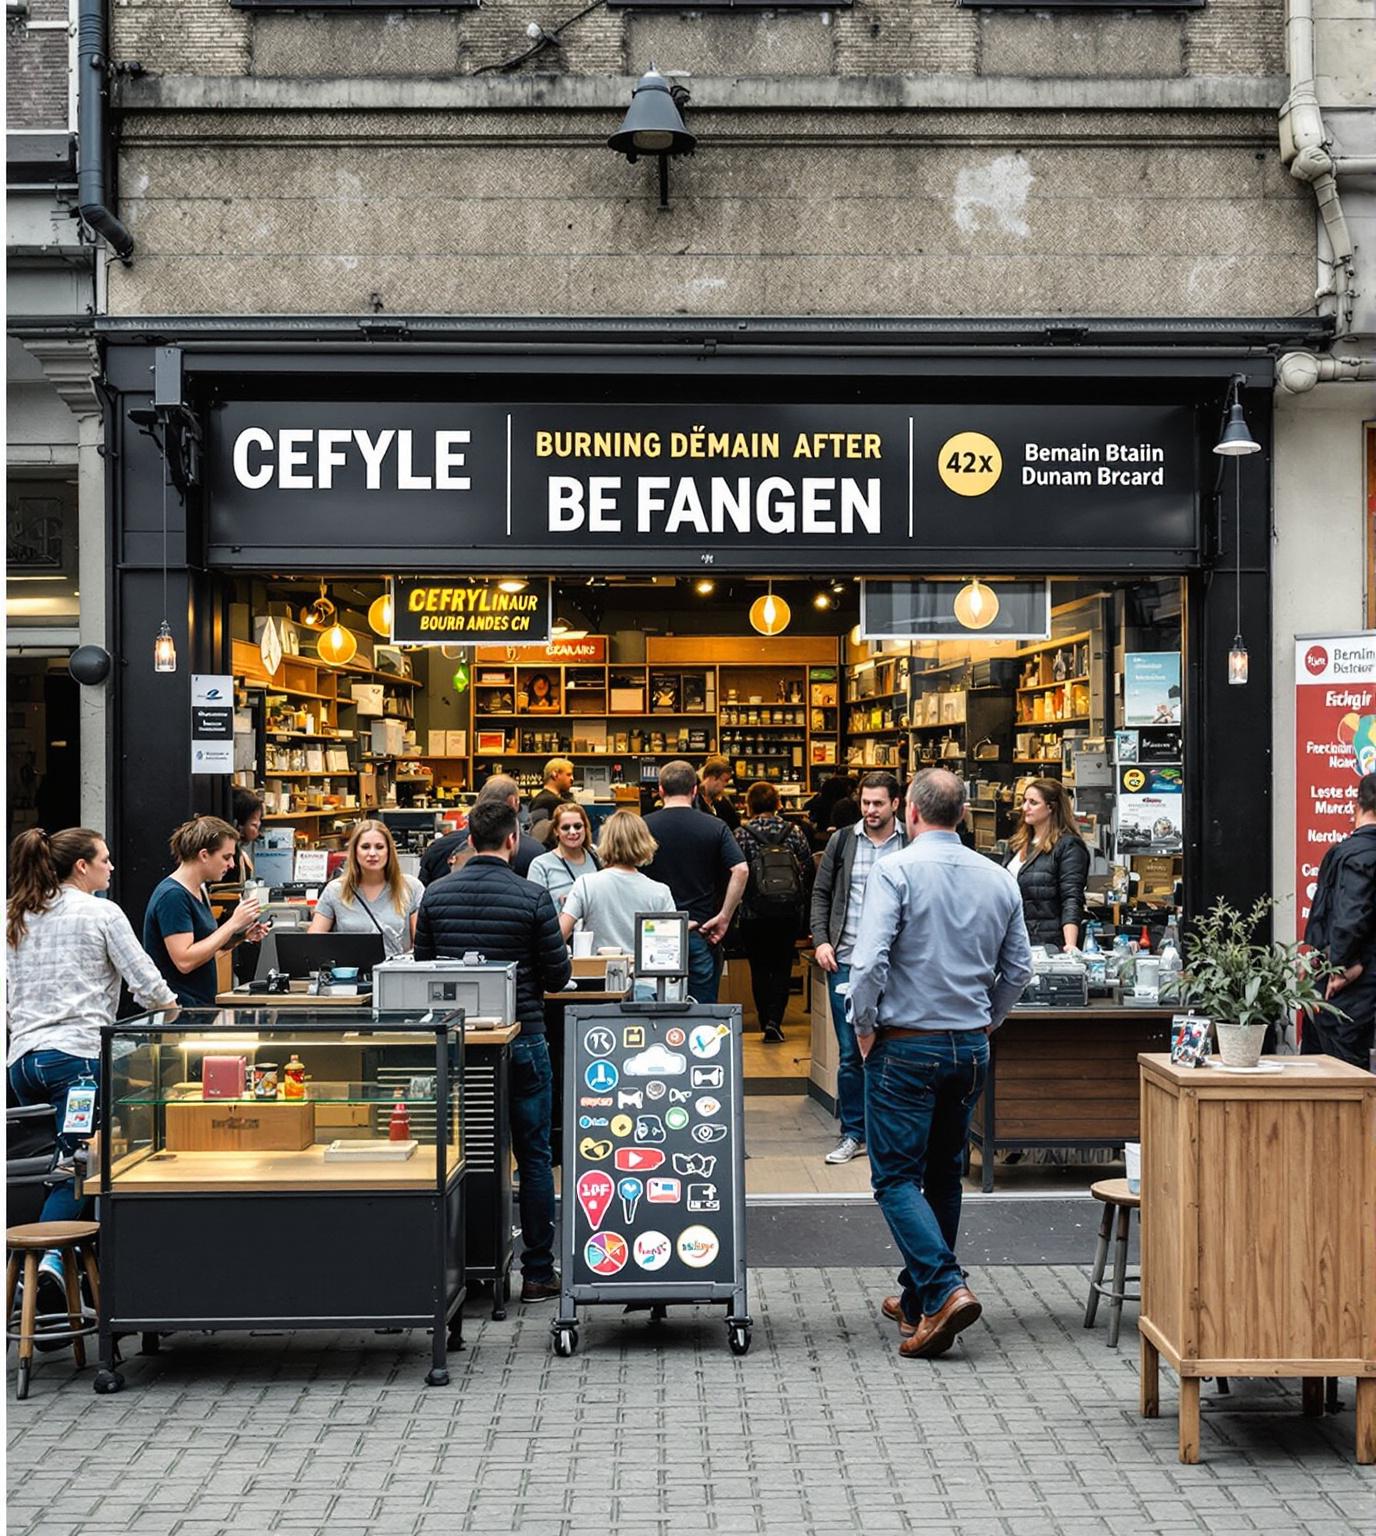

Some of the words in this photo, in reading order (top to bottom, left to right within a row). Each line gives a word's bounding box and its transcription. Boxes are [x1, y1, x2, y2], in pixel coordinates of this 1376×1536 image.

[536, 431, 661, 458] BURNING
[793, 433, 882, 459] AFTER
[1025, 443, 1099, 462] Bemain
[233, 427, 471, 490] CEFYLE
[946, 451, 993, 473] 42x
[1022, 467, 1092, 486] Dunam
[548, 476, 622, 533] BE
[637, 476, 881, 534] FANGEN
